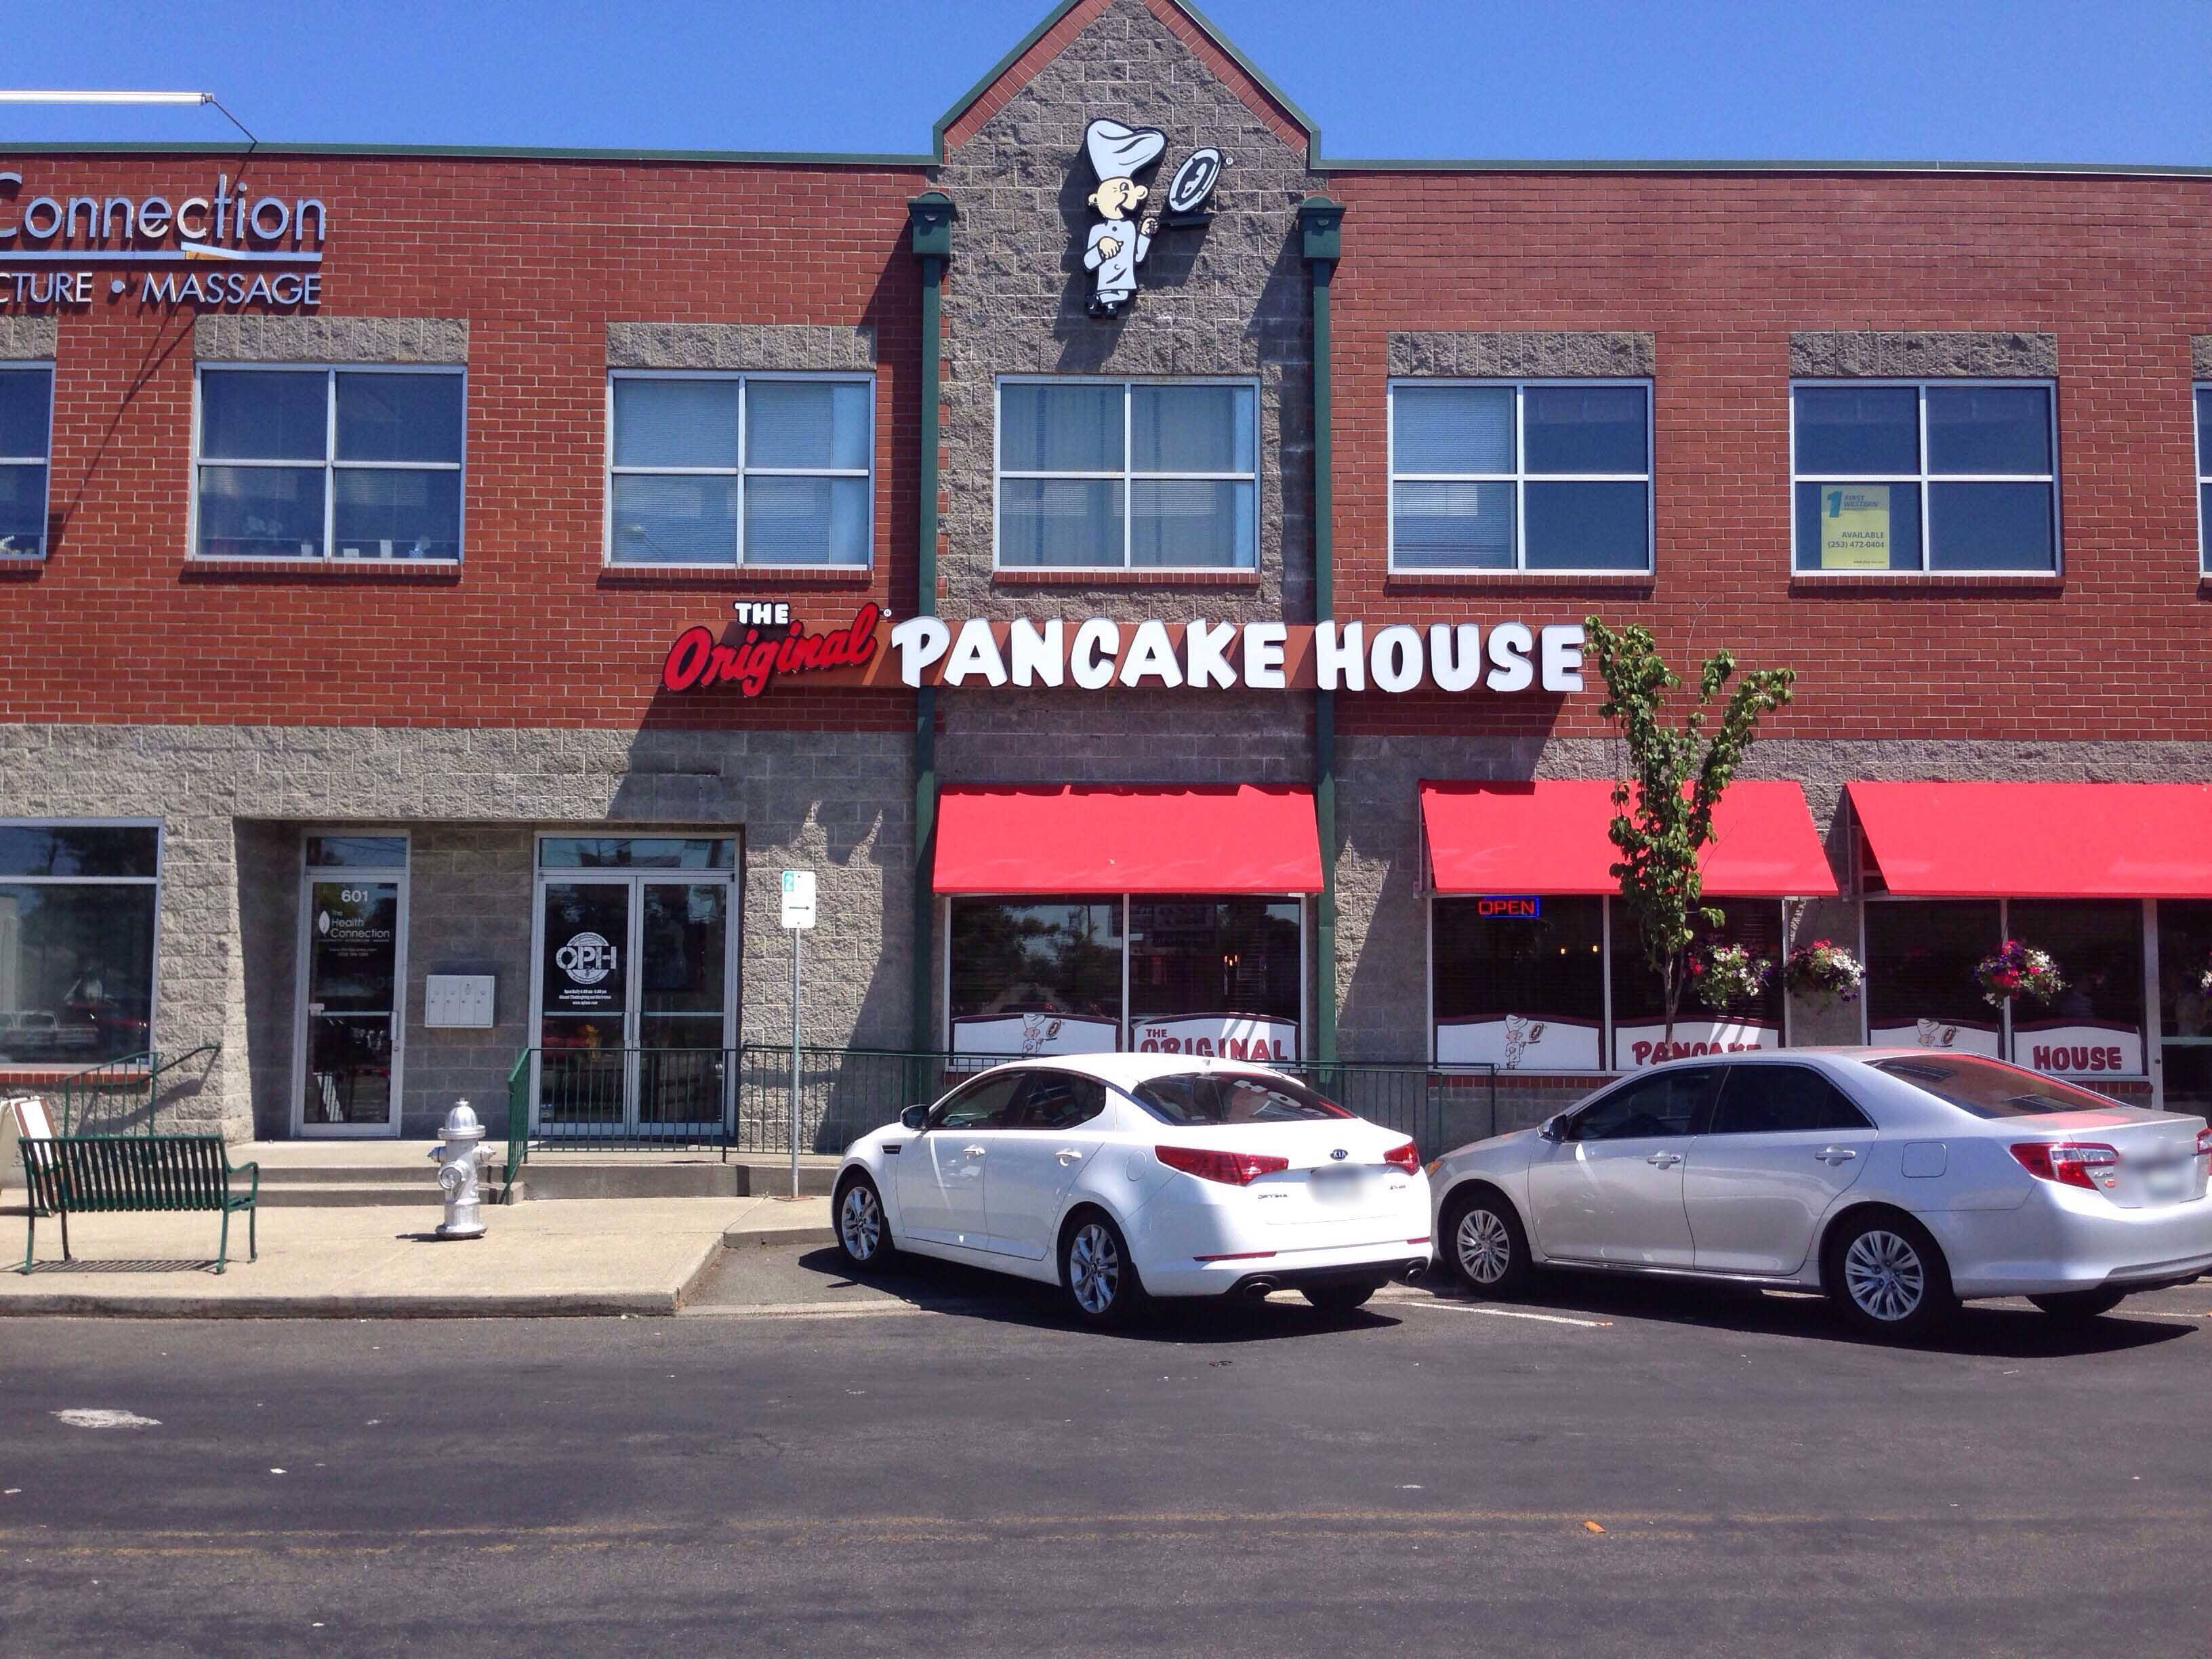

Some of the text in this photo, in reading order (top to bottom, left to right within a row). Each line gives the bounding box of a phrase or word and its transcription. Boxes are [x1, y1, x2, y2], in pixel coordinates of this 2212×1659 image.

[141, 272, 322, 305] MASSAGE
[734, 601, 790, 625] THE
[662, 602, 1585, 697] Original PANCAKE HOUSE
[341, 889, 368, 903] 601
[1478, 899, 1535, 916] OPEN
[331, 917, 364, 927] Health
[331, 928, 390, 938] Connection
[556, 945, 617, 970] OPH
[1145, 1028, 1168, 1038] THE
[2033, 1045, 2123, 1071] HOUSE
